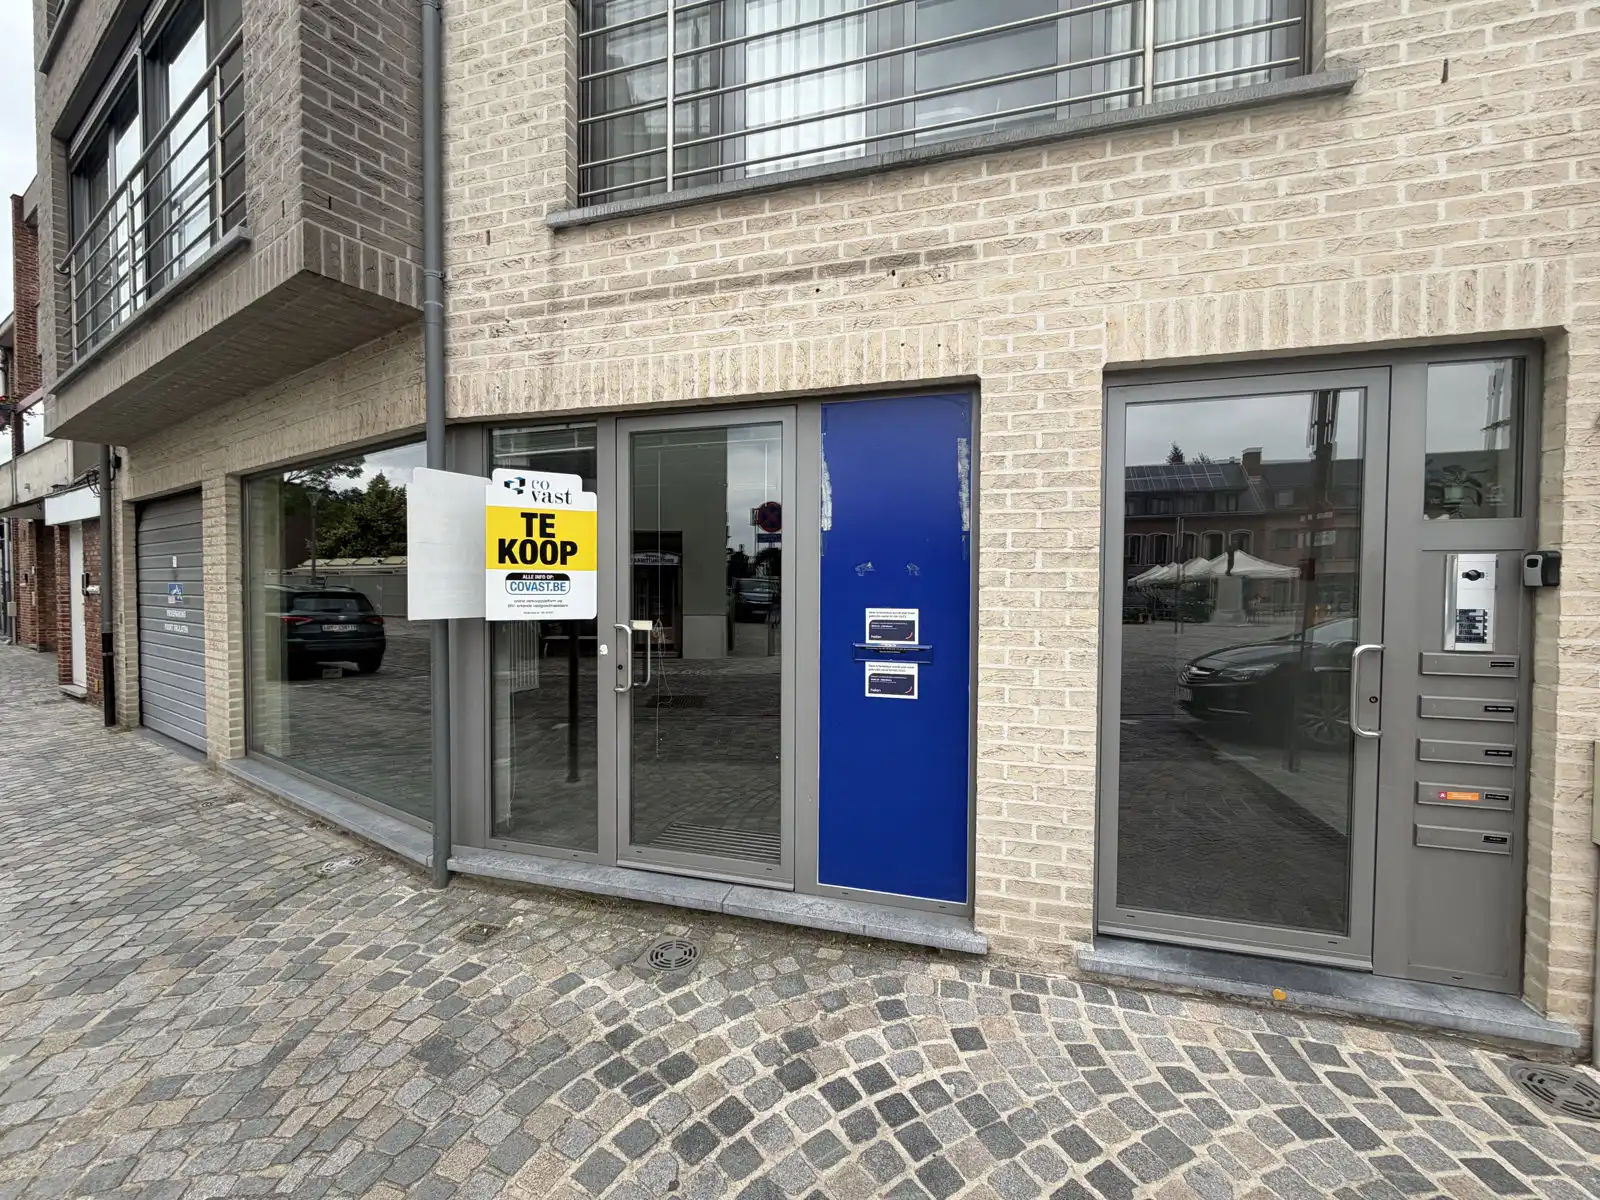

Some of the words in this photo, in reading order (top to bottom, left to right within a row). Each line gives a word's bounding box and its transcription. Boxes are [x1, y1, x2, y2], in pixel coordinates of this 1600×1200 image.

[531, 479, 550, 490] co
[531, 488, 573, 505] vast
[520, 511, 556, 539] TE
[497, 538, 578, 566] KOOP
[510, 581, 567, 592] COVAST.BE
